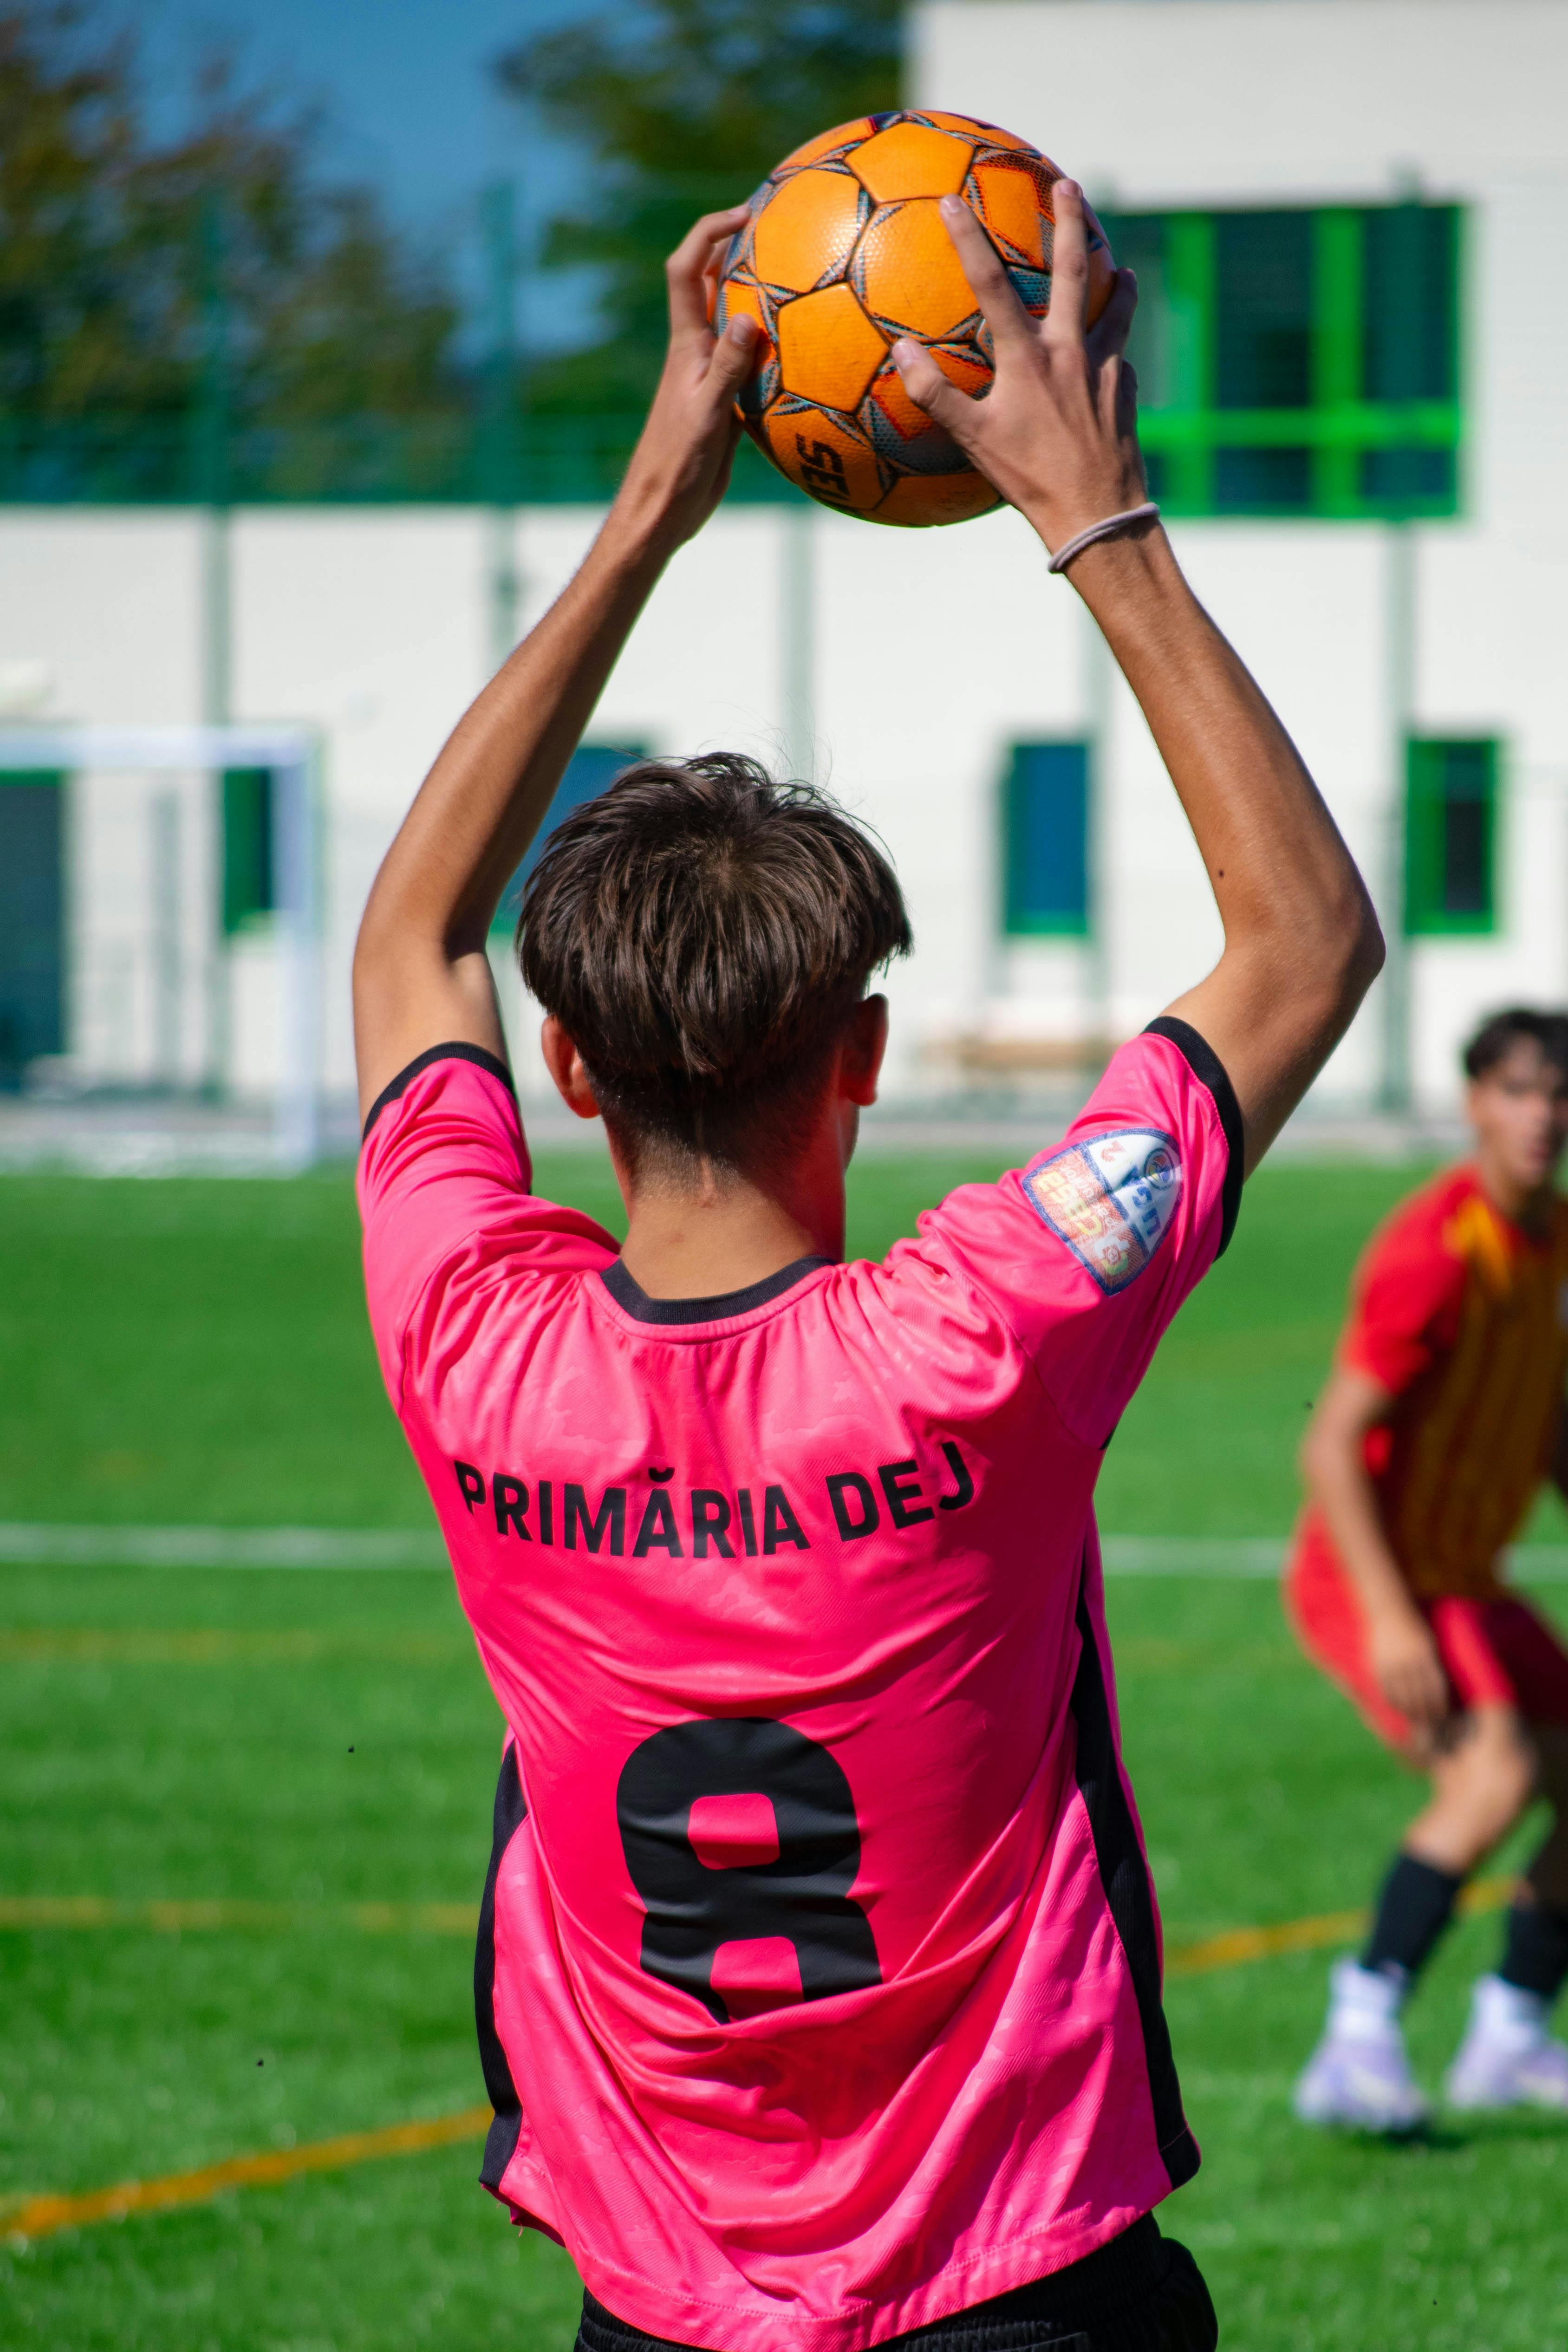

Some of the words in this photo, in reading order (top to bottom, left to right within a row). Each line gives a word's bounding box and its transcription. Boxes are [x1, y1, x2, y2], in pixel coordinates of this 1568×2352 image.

[1101, 1141, 1126, 1162] 2
[1122, 1163, 1161, 1238] LIGA
[454, 1460, 811, 1559] PRIMĂRIA
[825, 1441, 975, 1542] DEJ
[616, 1716, 883, 2026] 8
